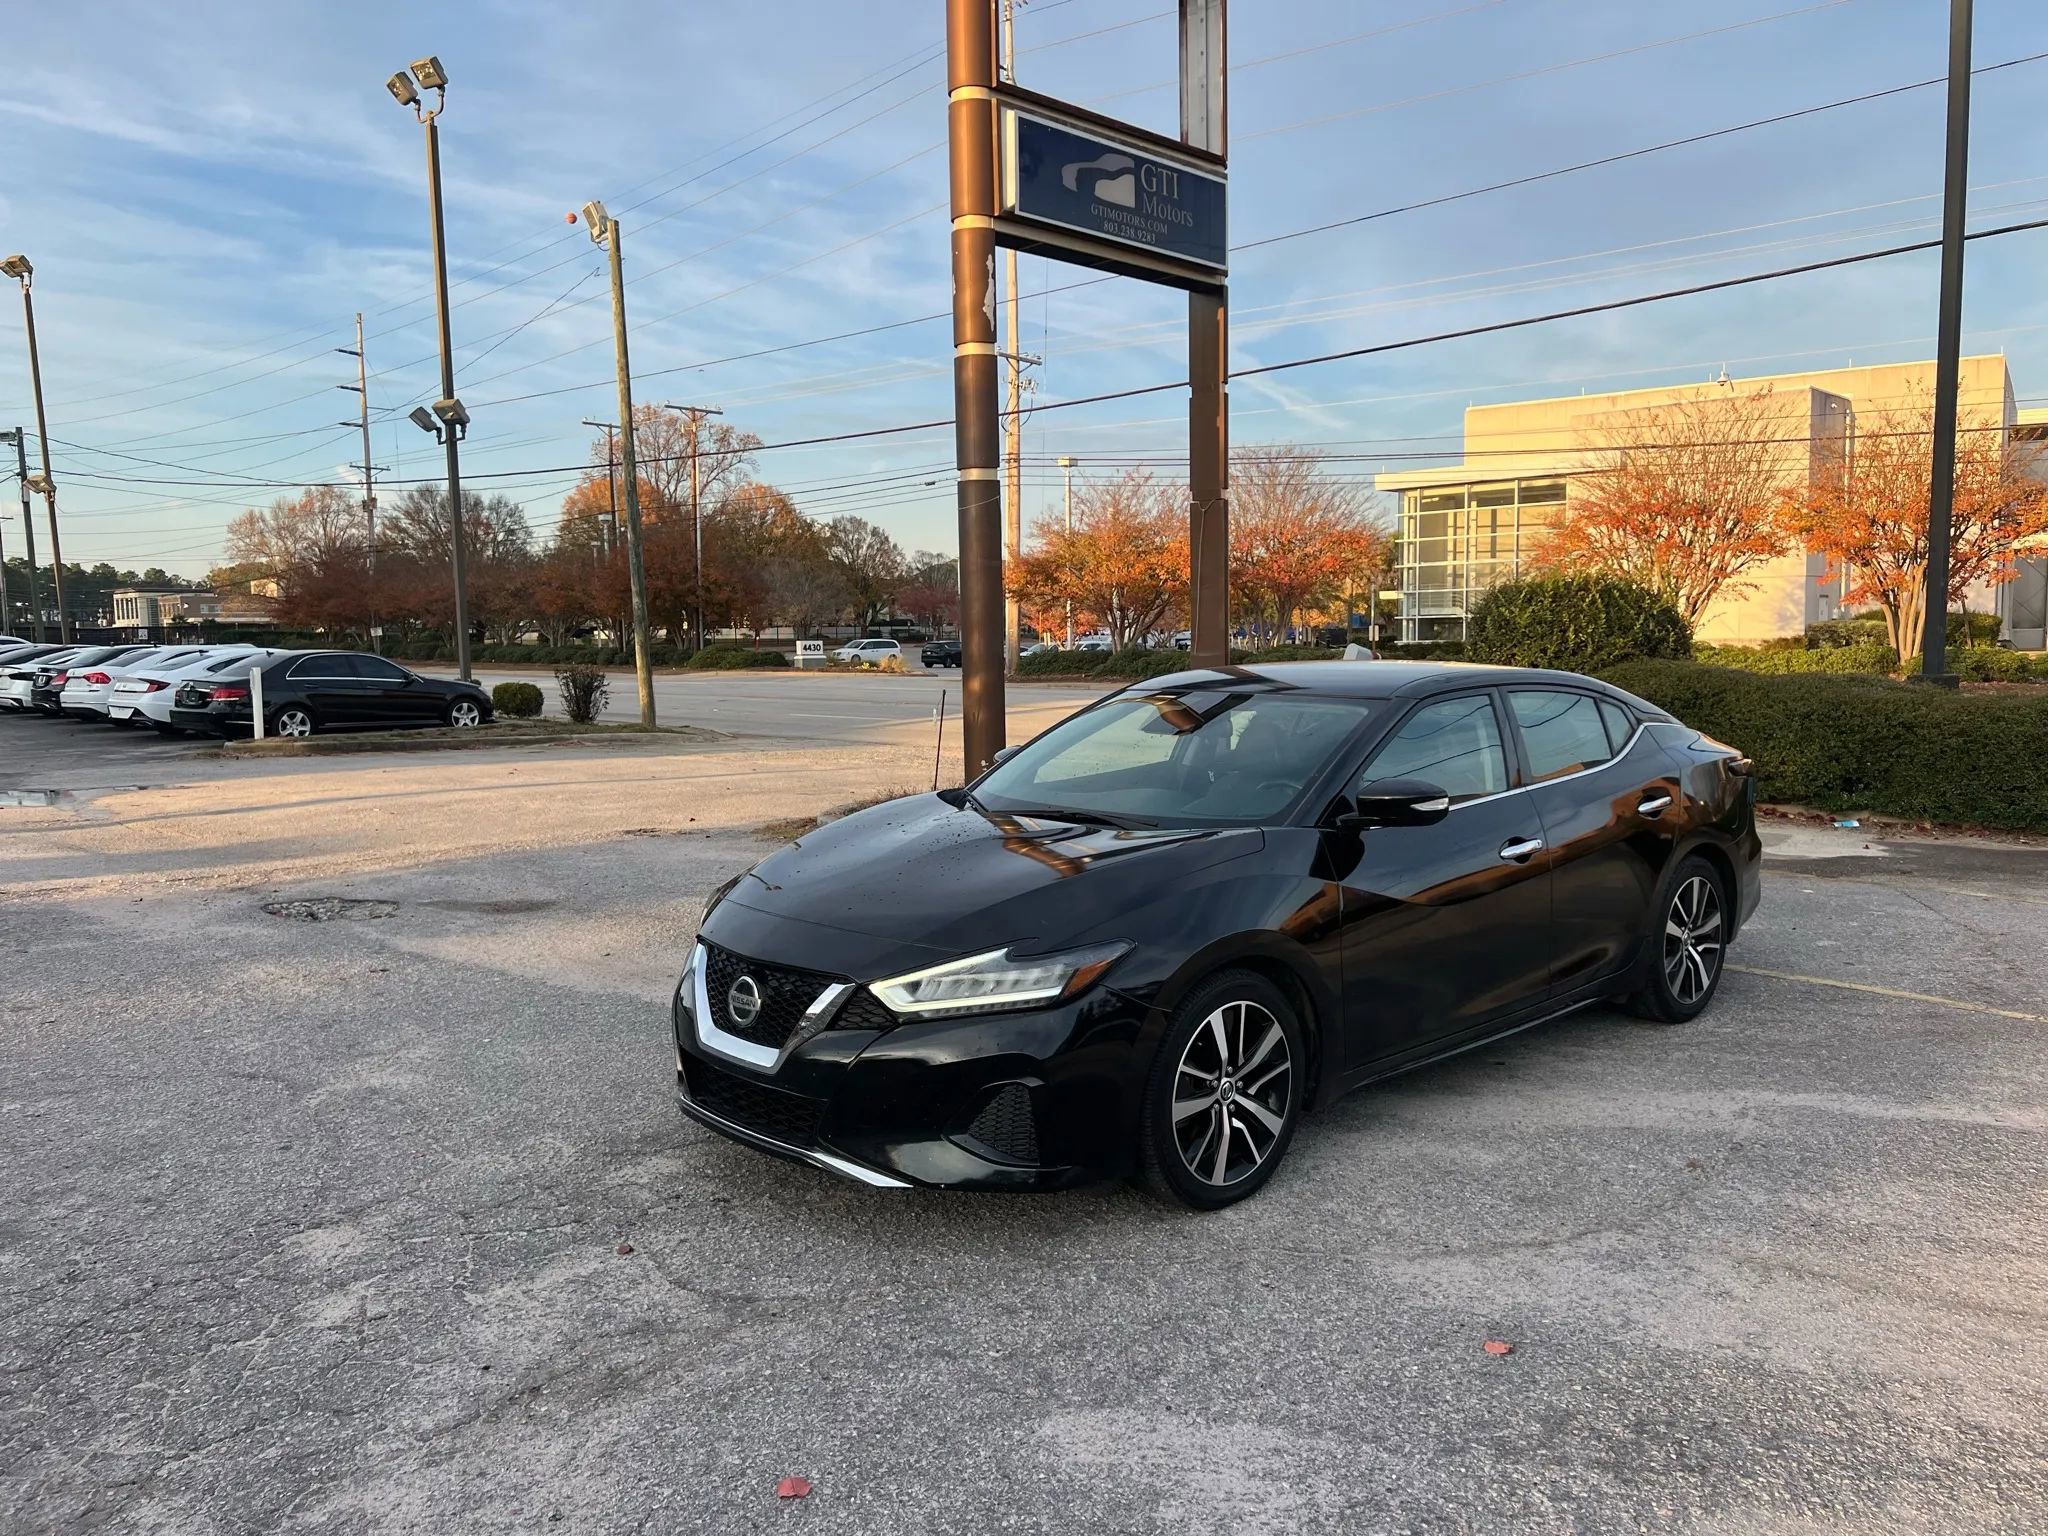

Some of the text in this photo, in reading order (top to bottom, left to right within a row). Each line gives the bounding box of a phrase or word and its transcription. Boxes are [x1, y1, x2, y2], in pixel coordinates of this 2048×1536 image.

[1140, 163, 1179, 200] GTI
[1091, 203, 1168, 234] GTIMOTORS.COM
[1143, 193, 1193, 227] Motors
[803, 643, 821, 652] 4430
[731, 994, 756, 1008] NISSAN
